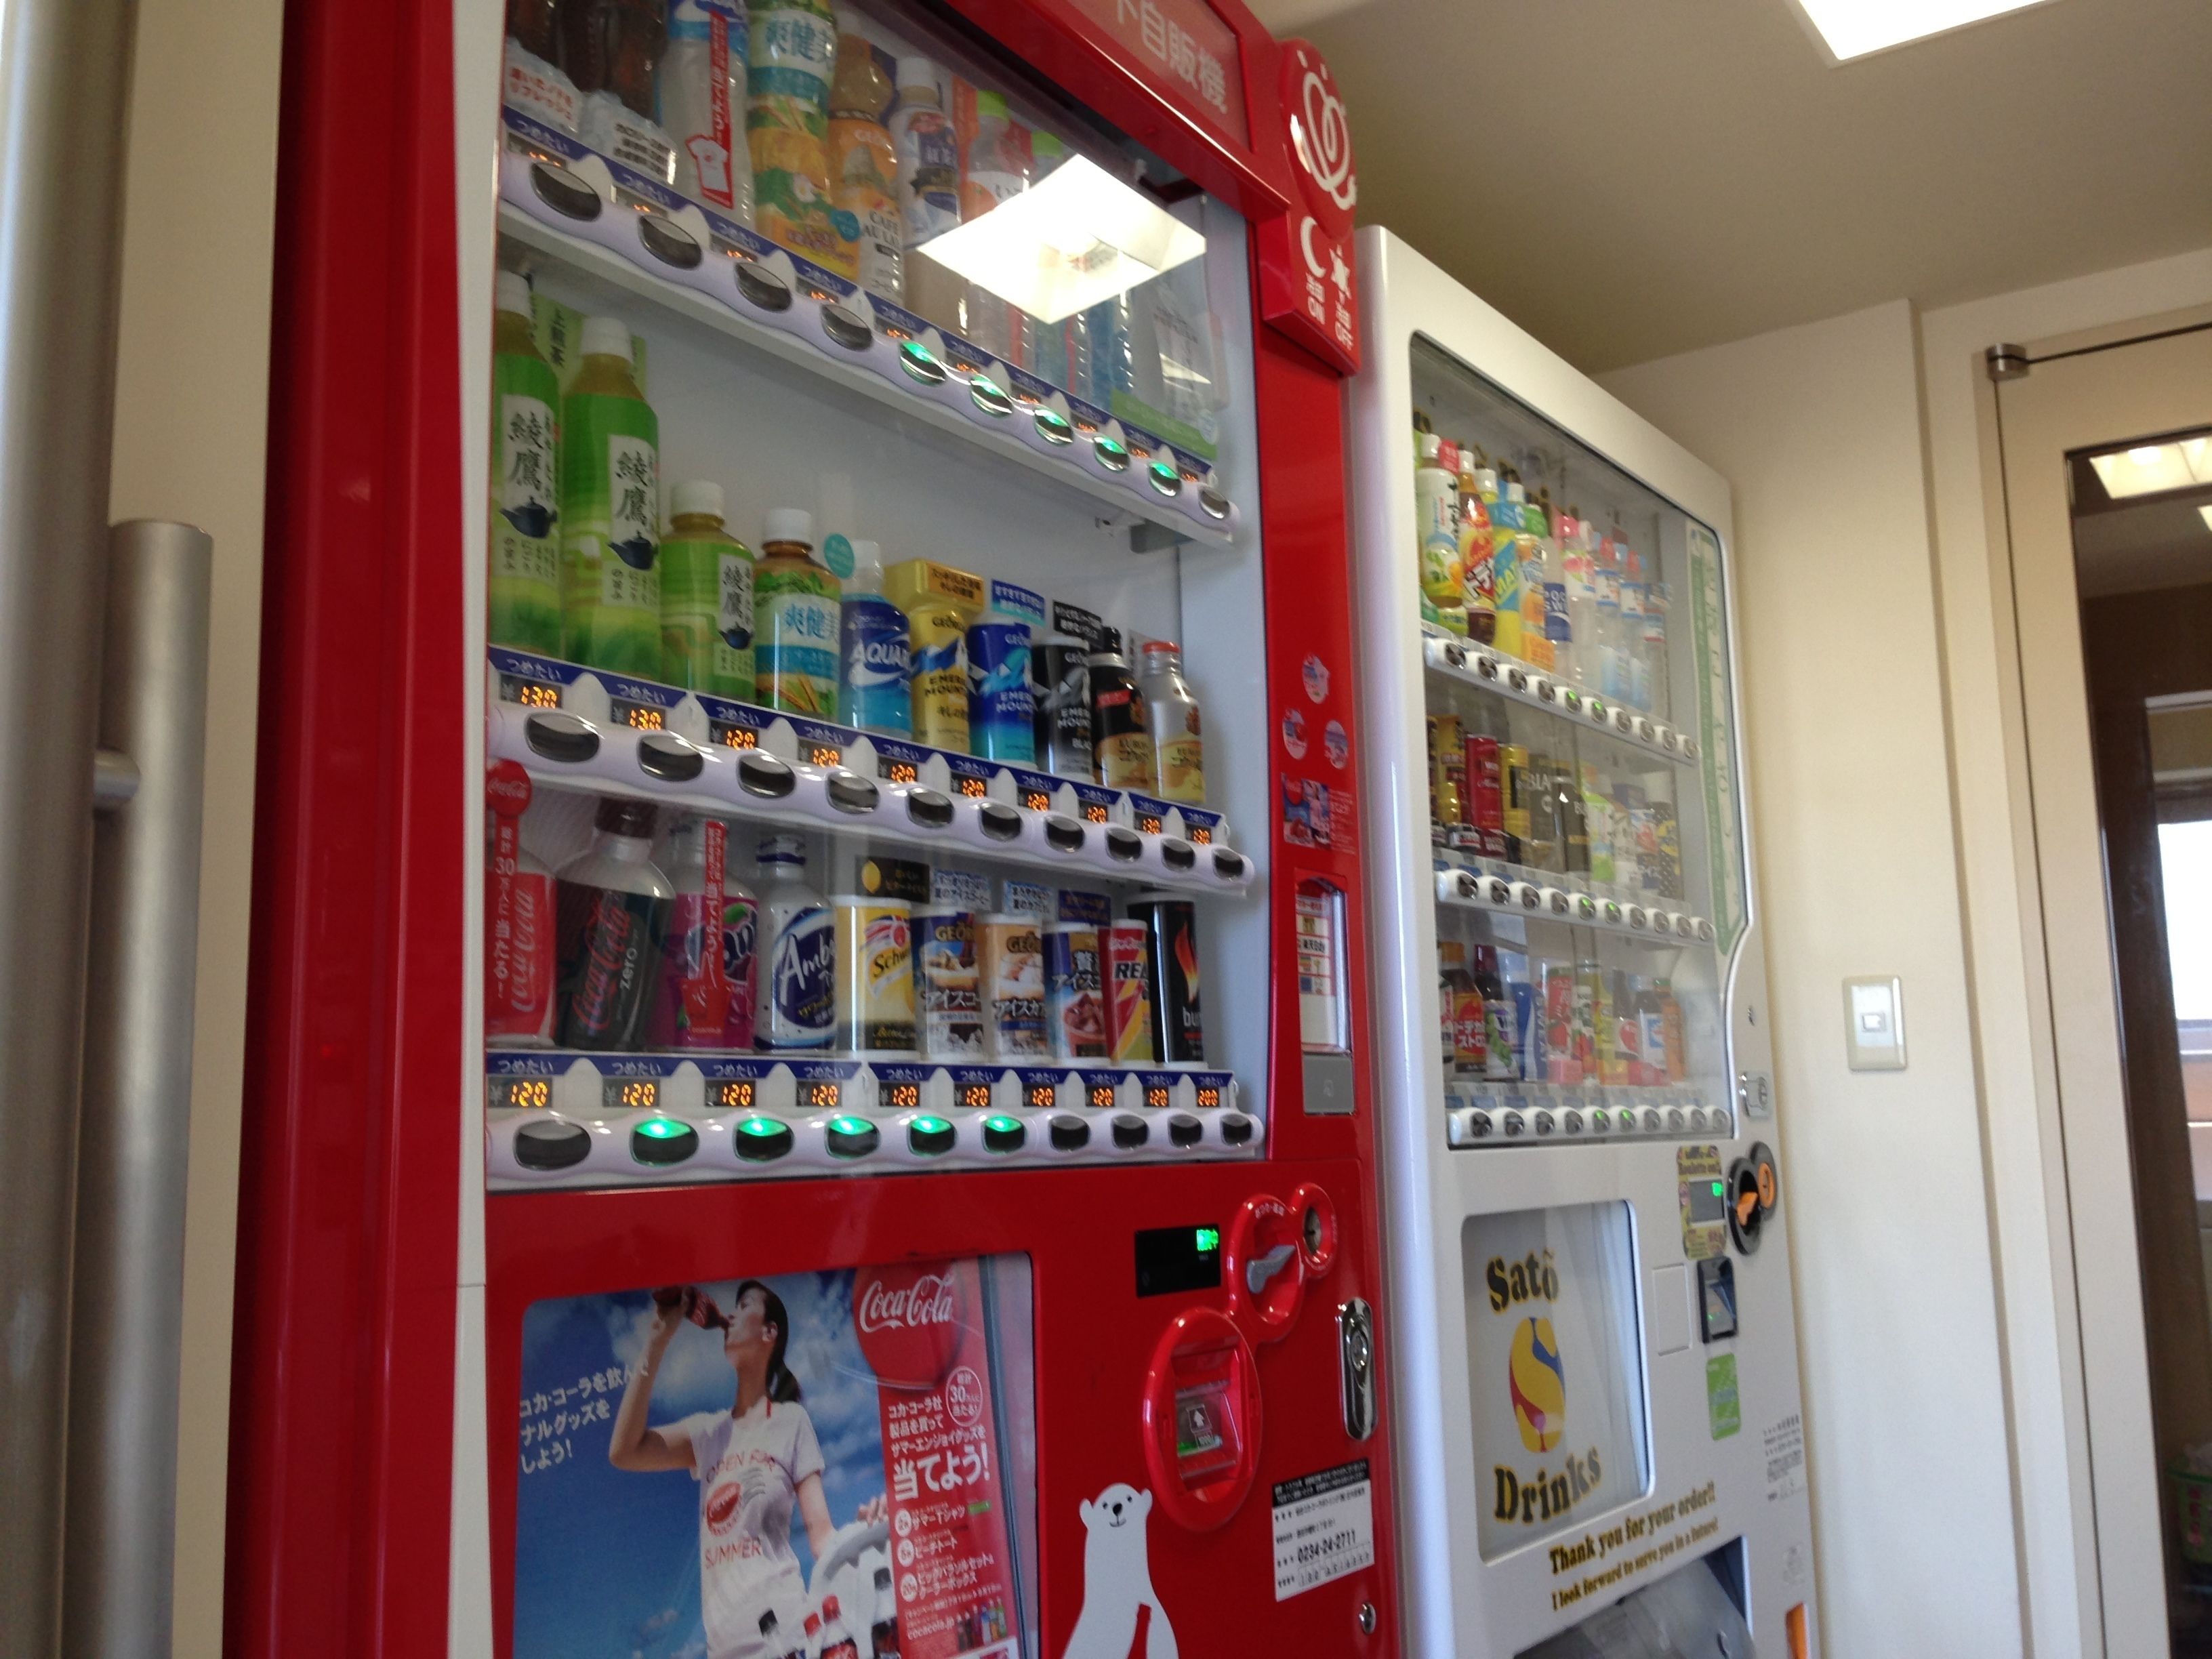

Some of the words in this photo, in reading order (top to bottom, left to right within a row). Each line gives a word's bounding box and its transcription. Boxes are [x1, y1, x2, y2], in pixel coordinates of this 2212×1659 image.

[507, 659, 561, 680] つめたい
[520, 686, 558, 710] 130
[617, 684, 666, 704] つめたい
[629, 709, 662, 731] 130
[716, 707, 760, 725] つめたい
[726, 729, 755, 751] 120
[804, 726, 844, 745] つめたい
[813, 748, 840, 768] 120
[884, 744, 920, 761] つめたい
[498, 1059, 554, 1076] つめたい
[611, 1061, 662, 1076] つめたい
[714, 1063, 758, 1078] つめたい
[803, 1065, 844, 1080] つめたい
[511, 1082, 548, 1109] 120
[623, 1083, 655, 1107] 120
[722, 1084, 752, 1106] 120
[812, 1085, 838, 1107] 120
[893, 1086, 917, 1107] 120
[966, 1086, 989, 1107] 120
[859, 1274, 955, 1333] Coca-Cola
[520, 1437, 573, 1475] しよう!
[893, 1441, 991, 1502] 当てよう!
[1493, 1446, 1602, 1524] Drinks
[1549, 1533, 1596, 1576] Thank
[1598, 1525, 1624, 1560] you
[1625, 1515, 1645, 1542] for
[1647, 1502, 1676, 1536] your
[704, 1536, 764, 1570] SUMMER
[1558, 1581, 1582, 1608] look
